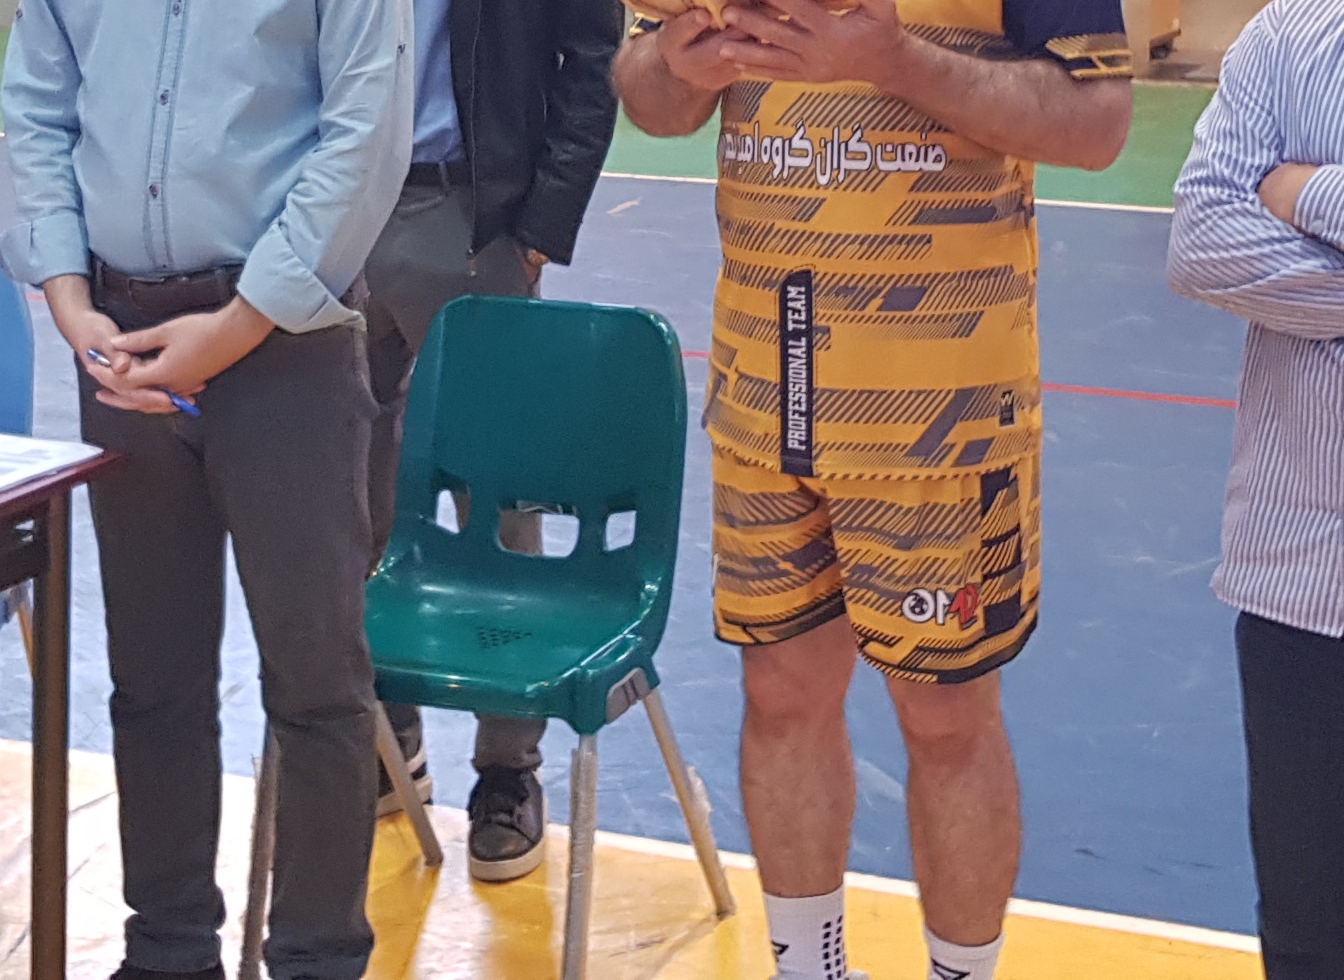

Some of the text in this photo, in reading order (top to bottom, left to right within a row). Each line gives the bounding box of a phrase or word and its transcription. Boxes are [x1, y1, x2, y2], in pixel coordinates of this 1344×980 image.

[761, 119, 814, 181] گروه
[787, 285, 807, 452] PROFESSIONAL TEAM
